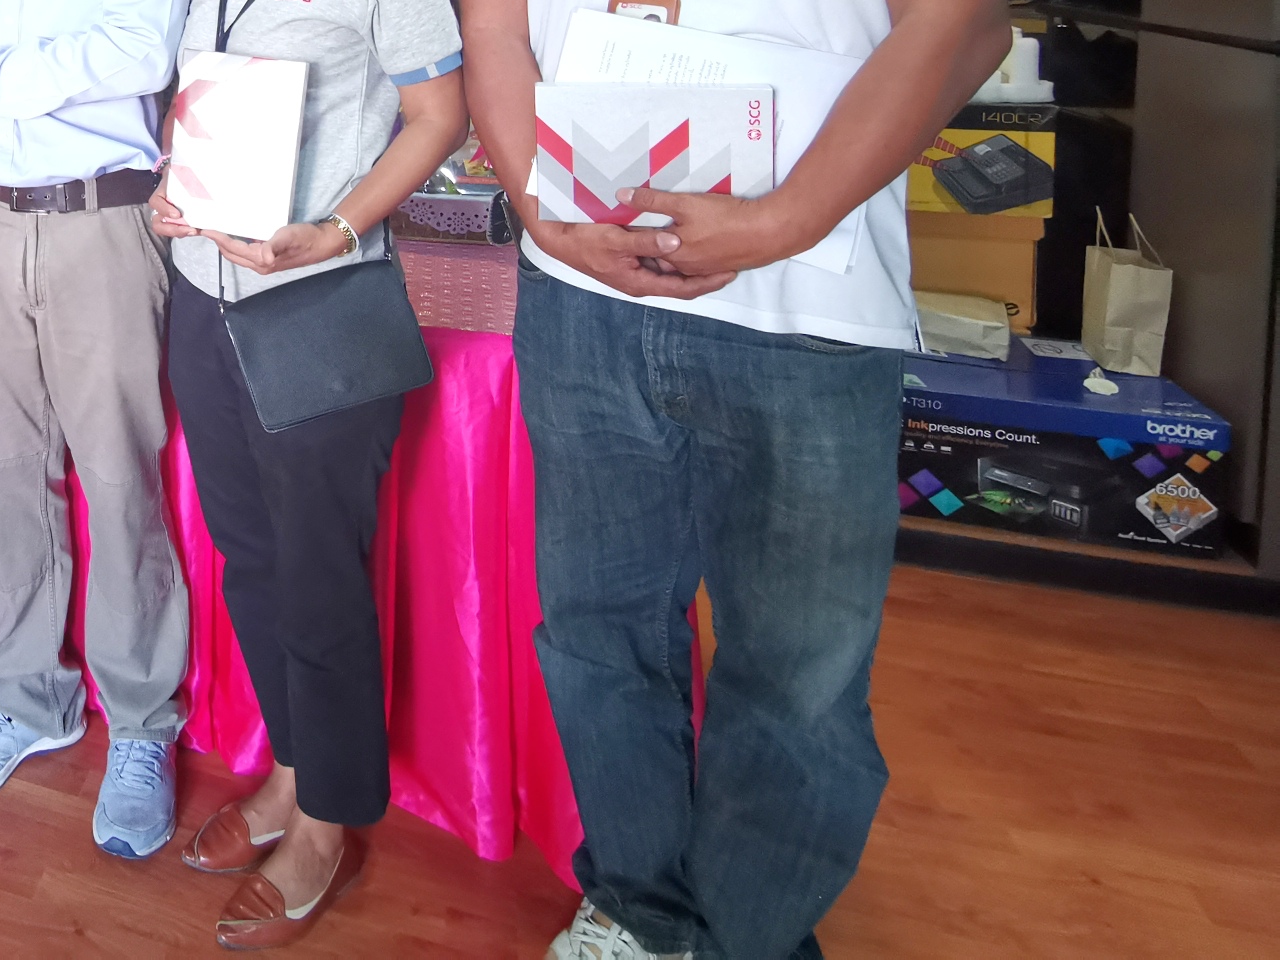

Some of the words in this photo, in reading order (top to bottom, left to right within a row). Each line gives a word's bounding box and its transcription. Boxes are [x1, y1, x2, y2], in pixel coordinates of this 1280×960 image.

[748, 100, 761, 126] SCG
[908, 418, 991, 439] Inkpressions
[995, 429, 1040, 444] Count.
[1146, 420, 1218, 440] brother
[1155, 483, 1200, 499] 6500
